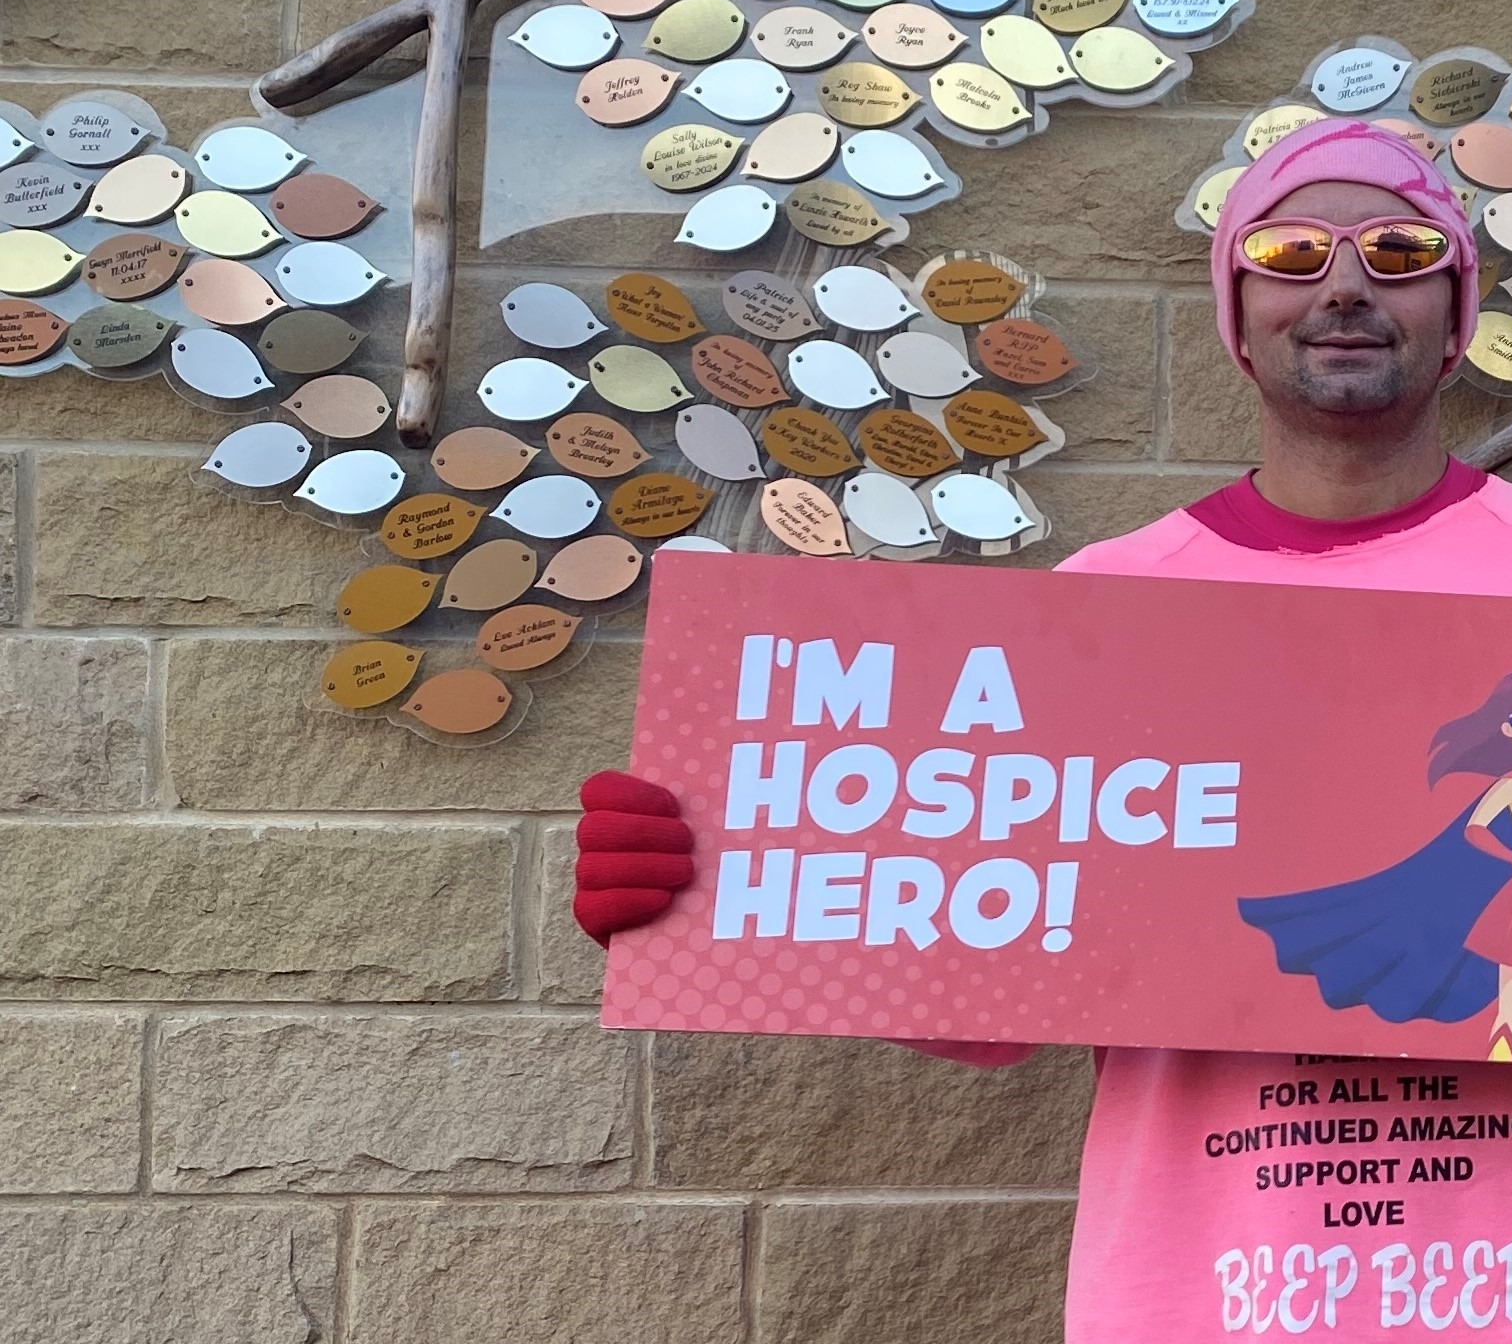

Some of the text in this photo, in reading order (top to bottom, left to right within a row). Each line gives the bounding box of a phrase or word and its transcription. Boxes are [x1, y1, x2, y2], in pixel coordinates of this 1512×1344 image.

[1175, 9, 1181, 17] &
[783, 26, 814, 36] Frank
[894, 23, 926, 35] Joyce
[785, 38, 814, 49] Ryan
[895, 36, 924, 47] Ryan
[1336, 59, 1373, 76] Andrew
[604, 75, 641, 94] Jeffrey
[836, 78, 893, 92] Reg Shaw
[1343, 73, 1374, 88] James
[1431, 67, 1474, 87] Richard
[955, 78, 1001, 101] Malcolm
[1337, 82, 1386, 101] McGivern
[956, 92, 992, 110] Brooks
[71, 115, 109, 126] Philip
[68, 128, 112, 139] Gornall
[671, 130, 697, 144] Sally
[653, 146, 686, 162] Louise
[15, 176, 50, 188] Kevin
[3, 185, 65, 204] Butterfield
[27, 204, 47, 214] xxx
[643, 286, 662, 299] Joy
[753, 282, 795, 305] Patrick
[740, 290, 759, 302] Life
[788, 310, 800, 319] of
[761, 310, 786, 324] party
[100, 322, 130, 334] Linda
[1001, 326, 1050, 343] Bernard
[94, 334, 141, 349] Marsden
[697, 357, 766, 395] John Richard
[706, 373, 750, 400] Chapman
[579, 425, 615, 440] Judith
[775, 425, 796, 443] Key
[787, 417, 818, 437] Thank
[567, 436, 576, 445] &
[397, 502, 451, 525] Raymond
[796, 491, 833, 519] Edward
[772, 501, 802, 525] Forever
[801, 524, 812, 533] in
[793, 503, 822, 526] Baker
[402, 517, 455, 538] & Gordon
[775, 517, 809, 544] thoughts
[412, 533, 454, 550] Barlow
[352, 659, 382, 676] Brian
[355, 671, 386, 689] Green
[735, 634, 1024, 734] I'M A
[723, 740, 1241, 849] HOSPICE
[712, 848, 1080, 952] HERO!
[1259, 1075, 1459, 1111] FOR ALL THE
[1205, 1118, 1379, 1158] CONTINUED
[1256, 1156, 1474, 1190] SUPPORT AND
[1324, 1200, 1405, 1228] LOVE
[1214, 1244, 1359, 1335] BEEP
